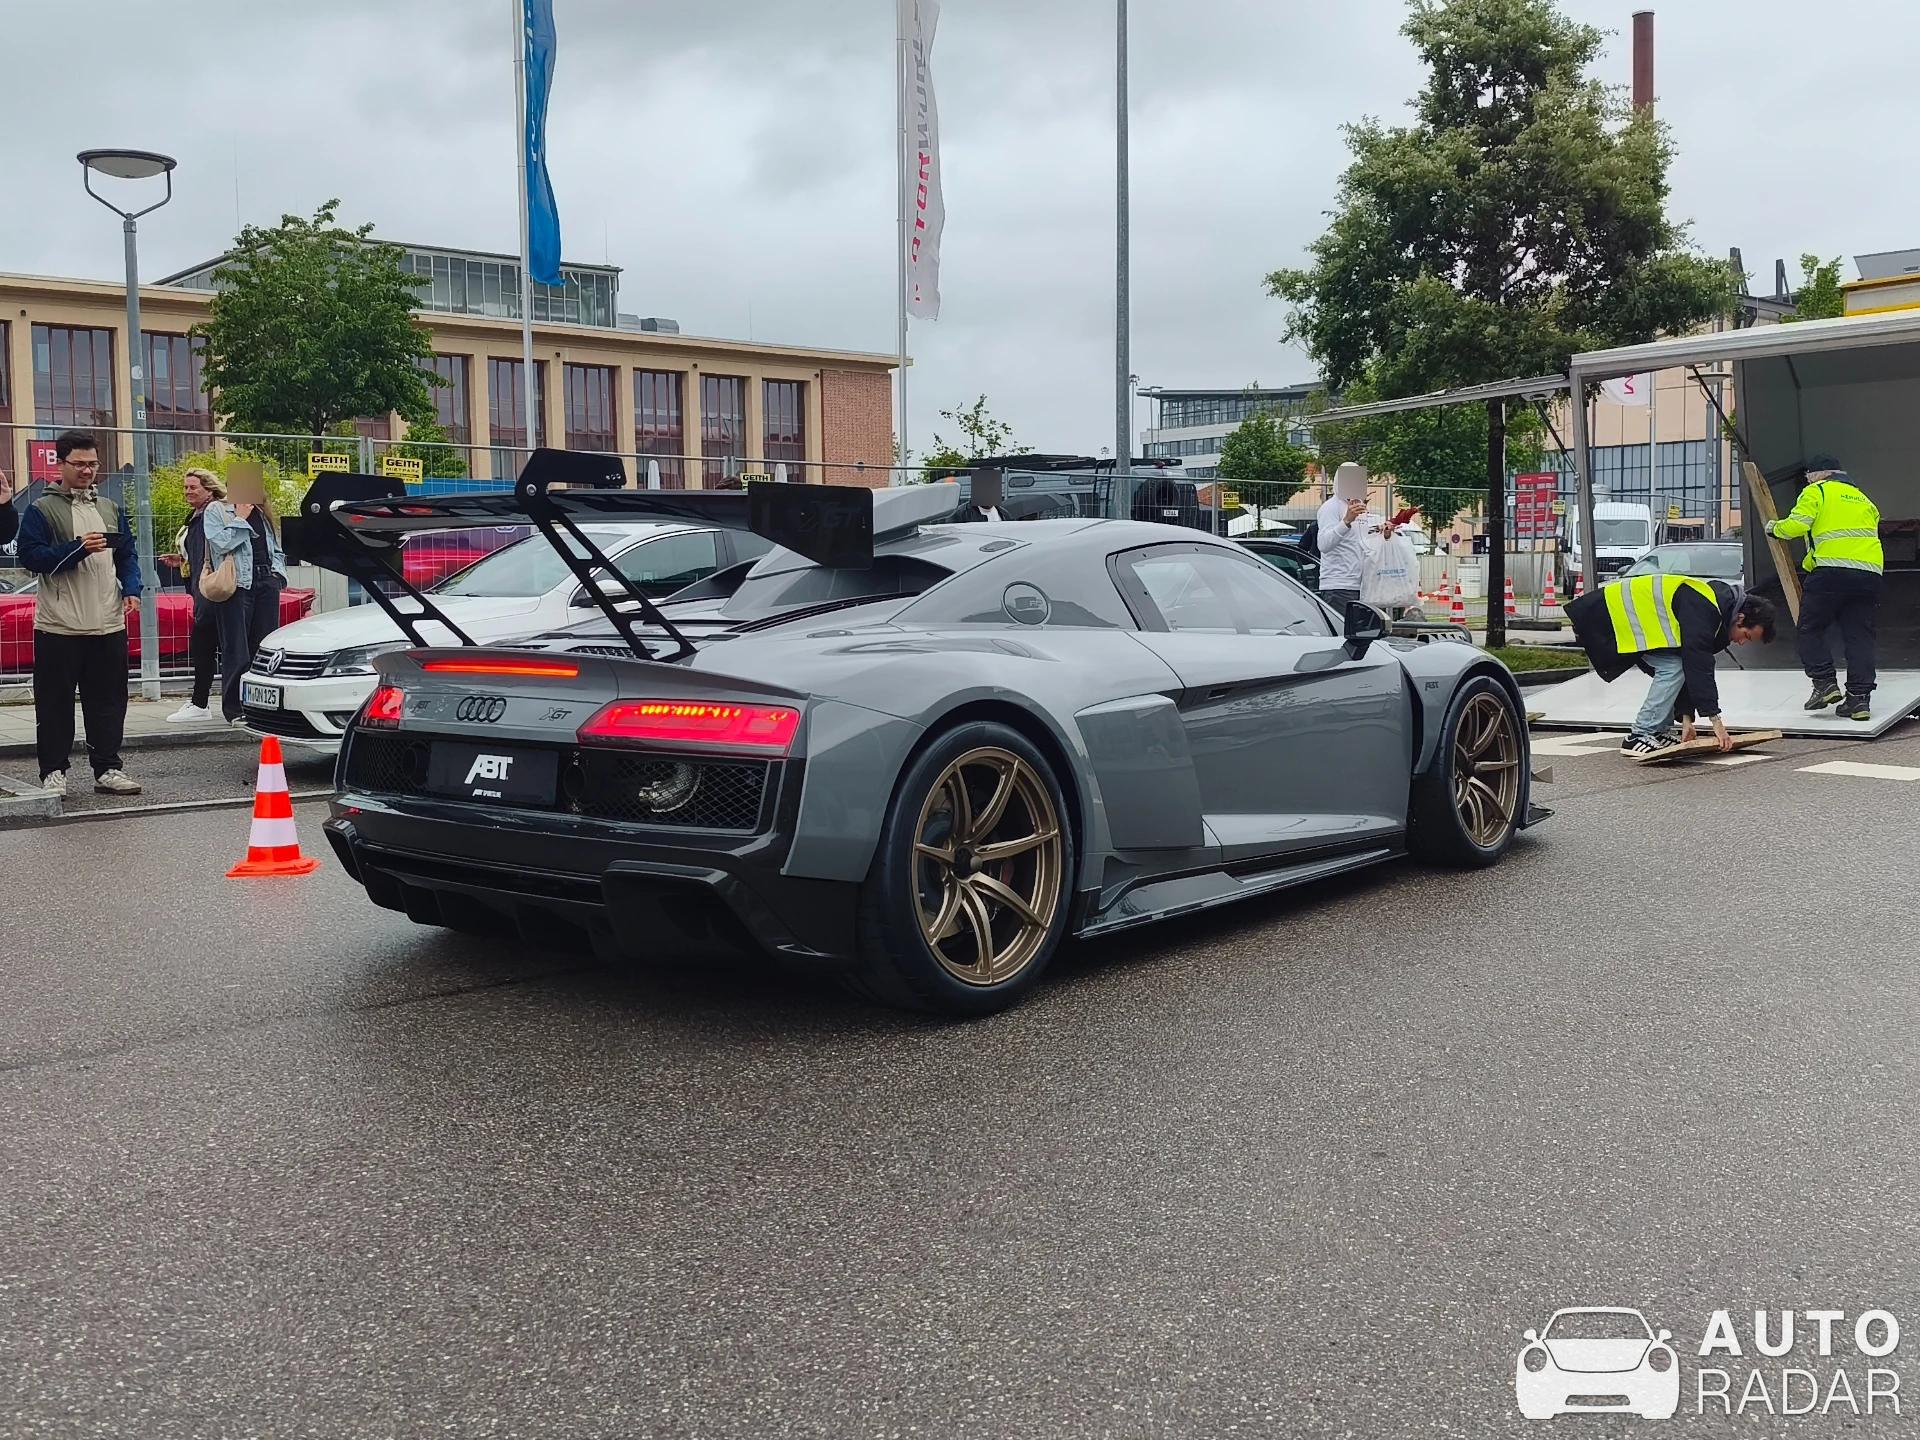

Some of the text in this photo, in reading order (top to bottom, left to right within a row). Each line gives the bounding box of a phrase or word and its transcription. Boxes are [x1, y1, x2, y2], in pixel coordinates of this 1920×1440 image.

[312, 455, 348, 464] GEITH
[386, 458, 419, 468] GEITH
[1425, 681, 1439, 691] ABT
[412, 700, 431, 713] ABT
[464, 753, 514, 785] ABT
